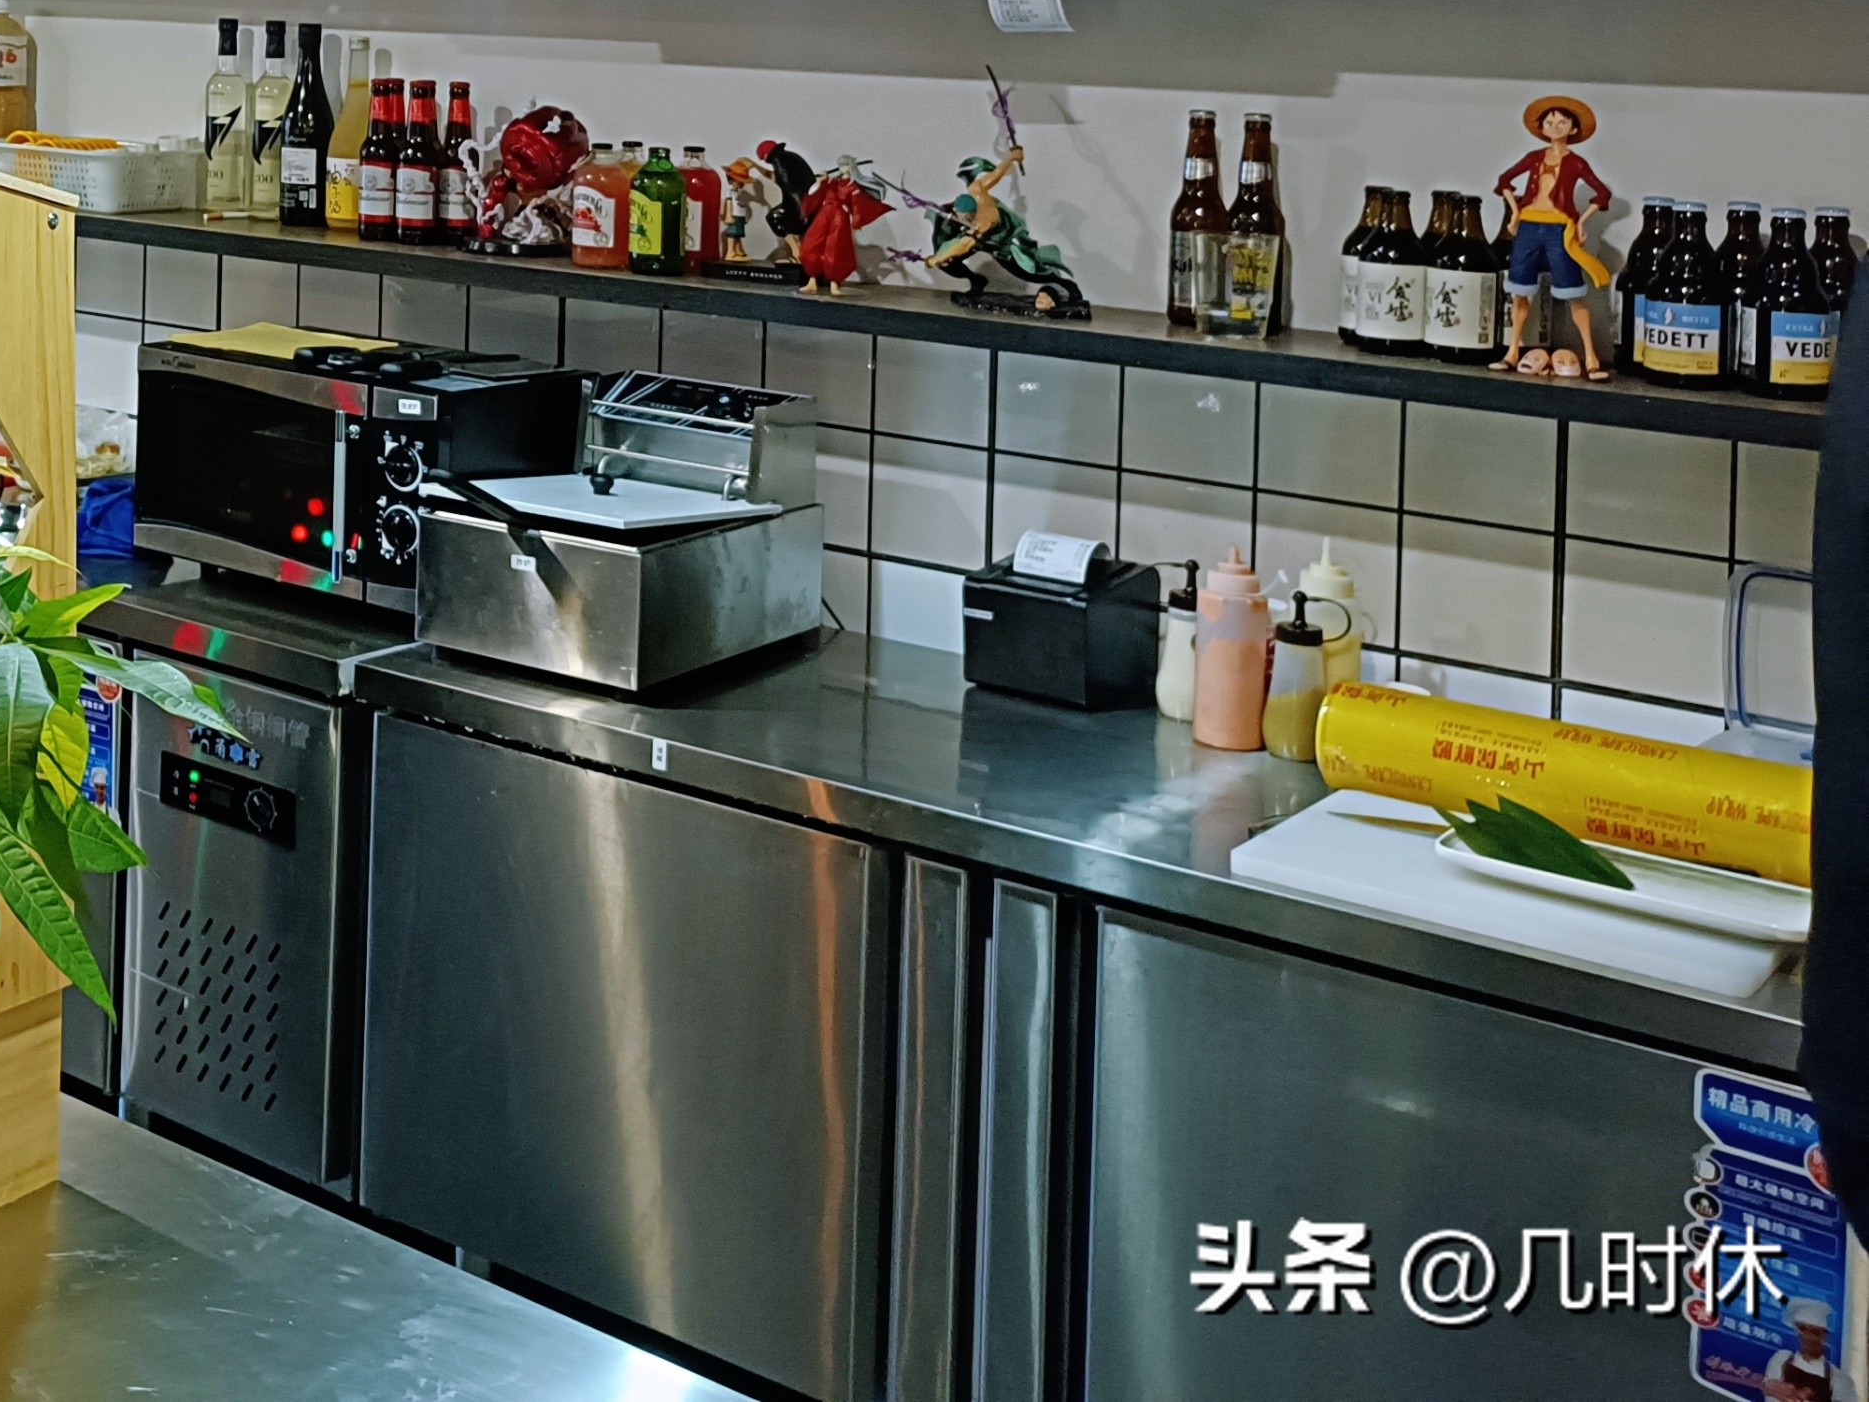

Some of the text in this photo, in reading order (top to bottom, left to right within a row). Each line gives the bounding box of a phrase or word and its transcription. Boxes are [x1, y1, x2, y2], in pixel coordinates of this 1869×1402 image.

[1432, 737, 1546, 780] 山河保鲜膜
[1585, 816, 1707, 858] 山河保鲜膜
